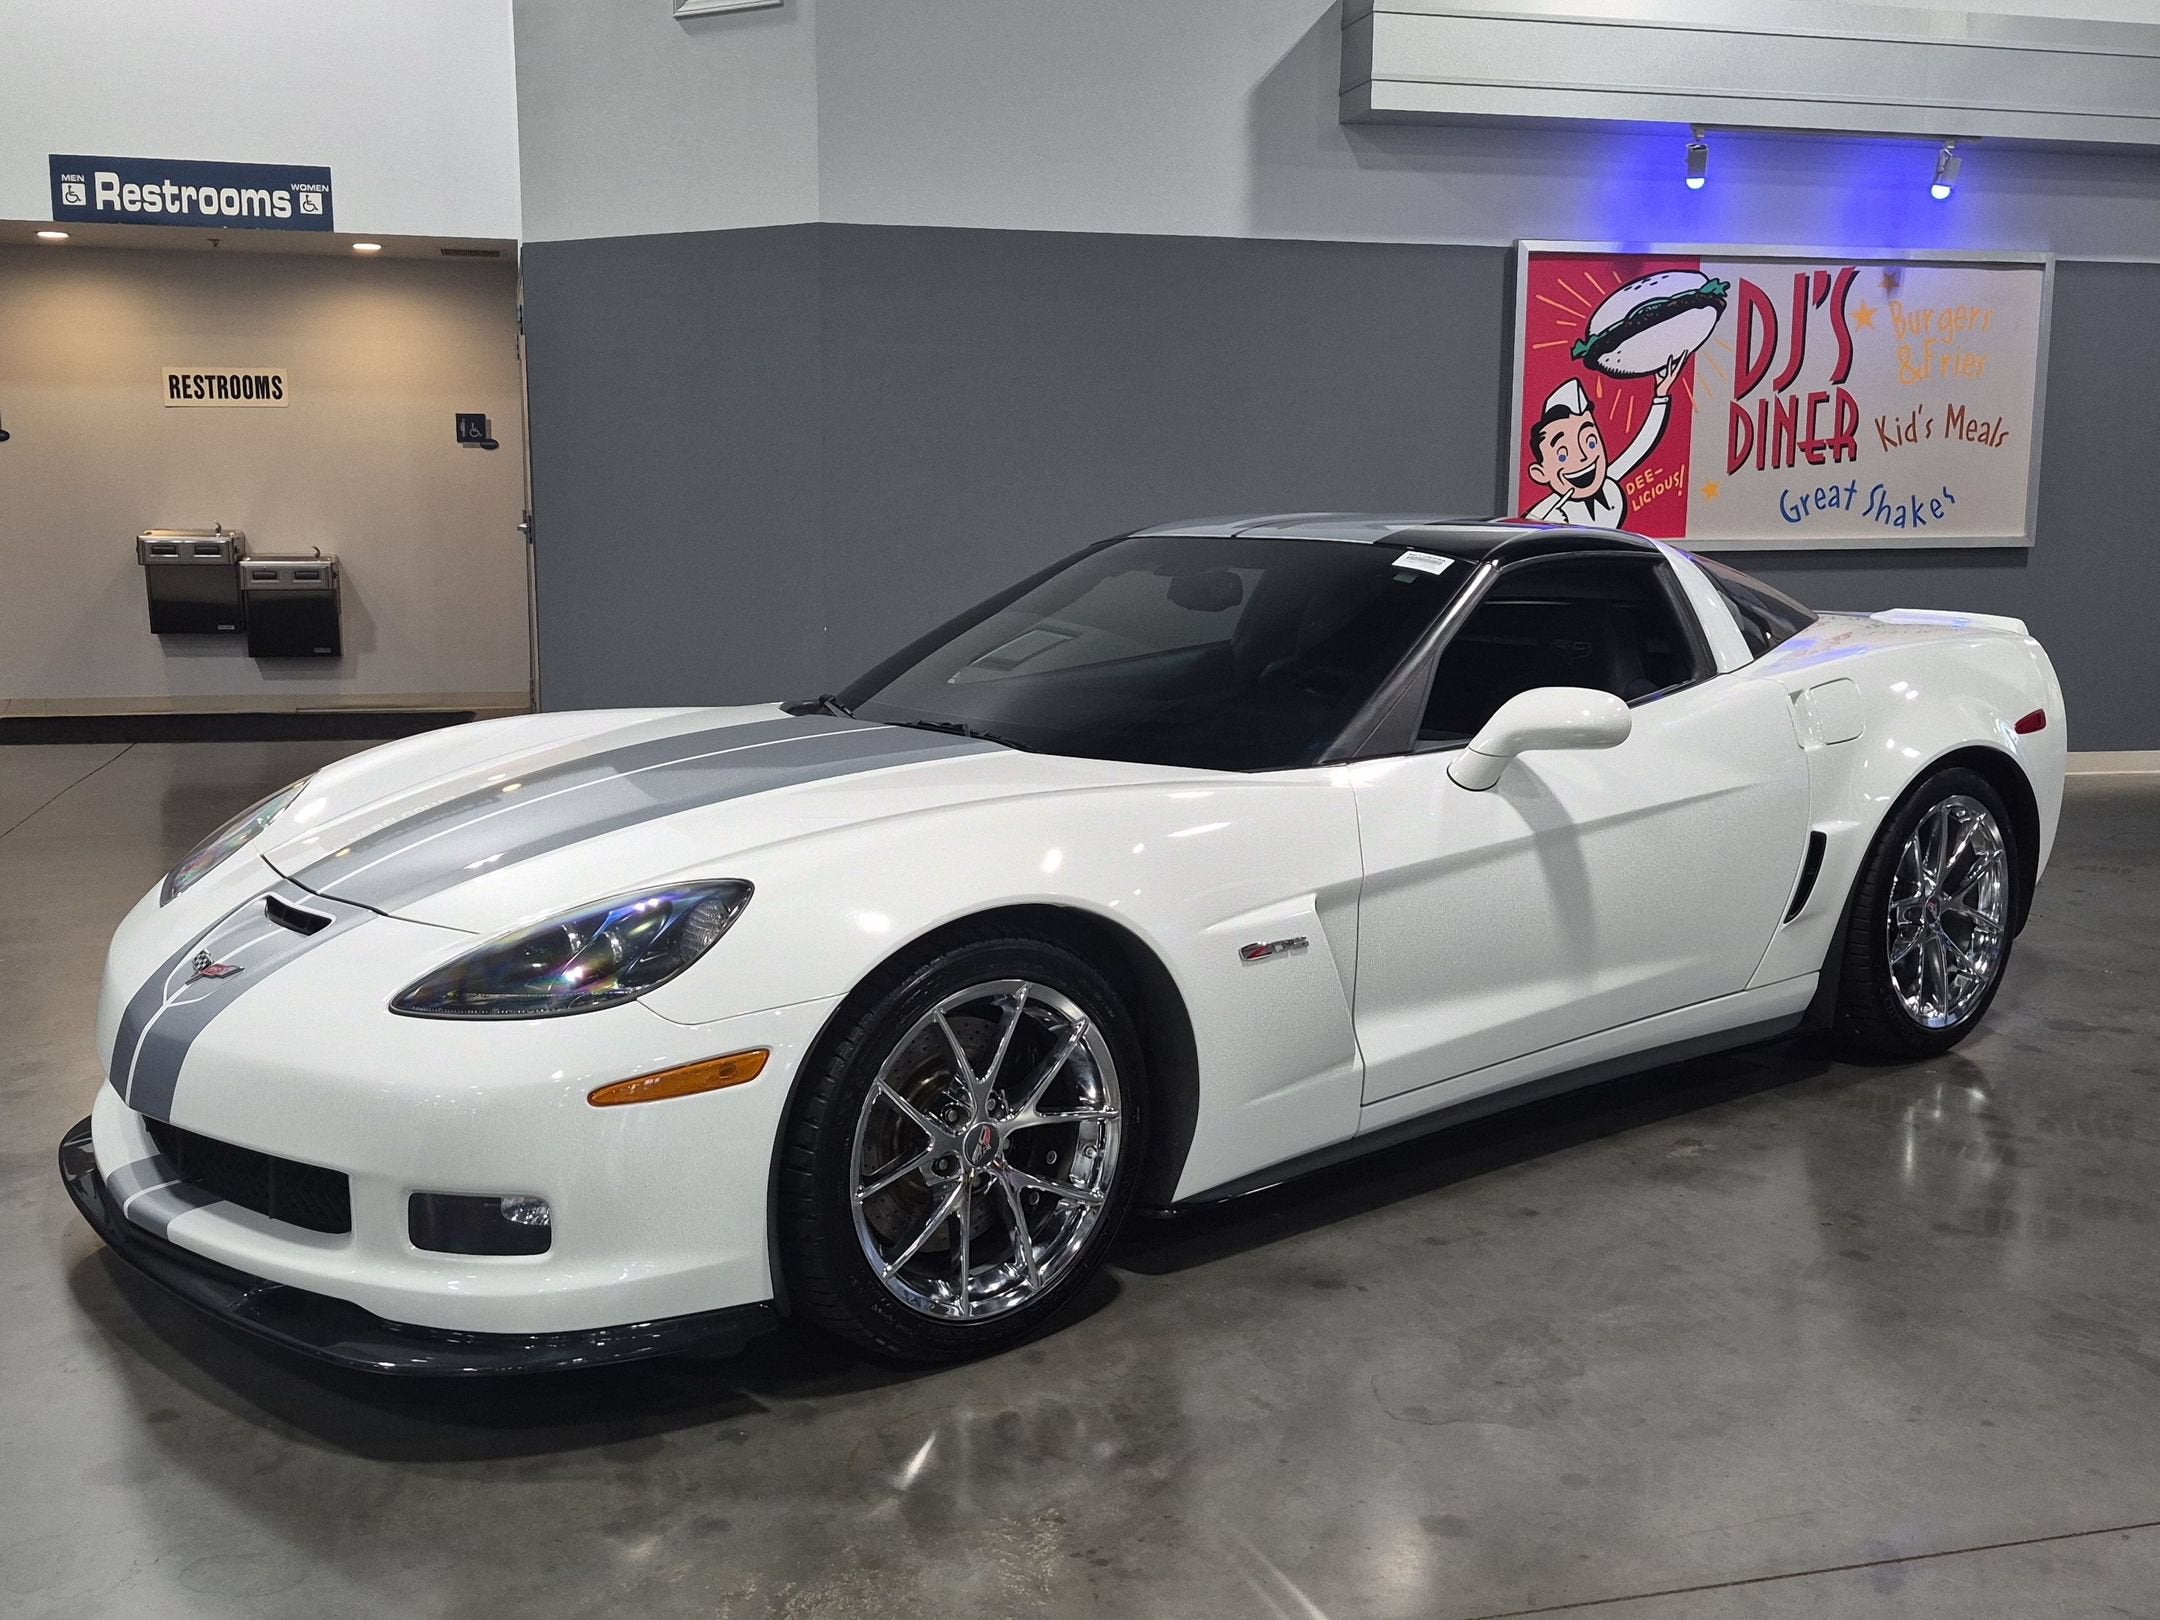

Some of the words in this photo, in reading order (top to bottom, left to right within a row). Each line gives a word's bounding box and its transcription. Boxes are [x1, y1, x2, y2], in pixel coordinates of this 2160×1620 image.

[61, 174, 85, 182] MEN
[94, 171, 292, 218] Restrooms
[290, 183, 330, 193] WOMEN
[1733, 266, 1861, 401] DJ'S
[1888, 300, 1996, 344] Burgers
[168, 374, 284, 400] RESTROOMS
[1726, 386, 1860, 476] DINER
[1874, 403, 1934, 453] Kid's
[1944, 403, 2010, 448] Meals
[1625, 468, 1664, 496] DEE-
[1631, 464, 1685, 512] LICIOUS!
[1779, 479, 1858, 524] Great
[1862, 483, 1956, 529] Shakes
